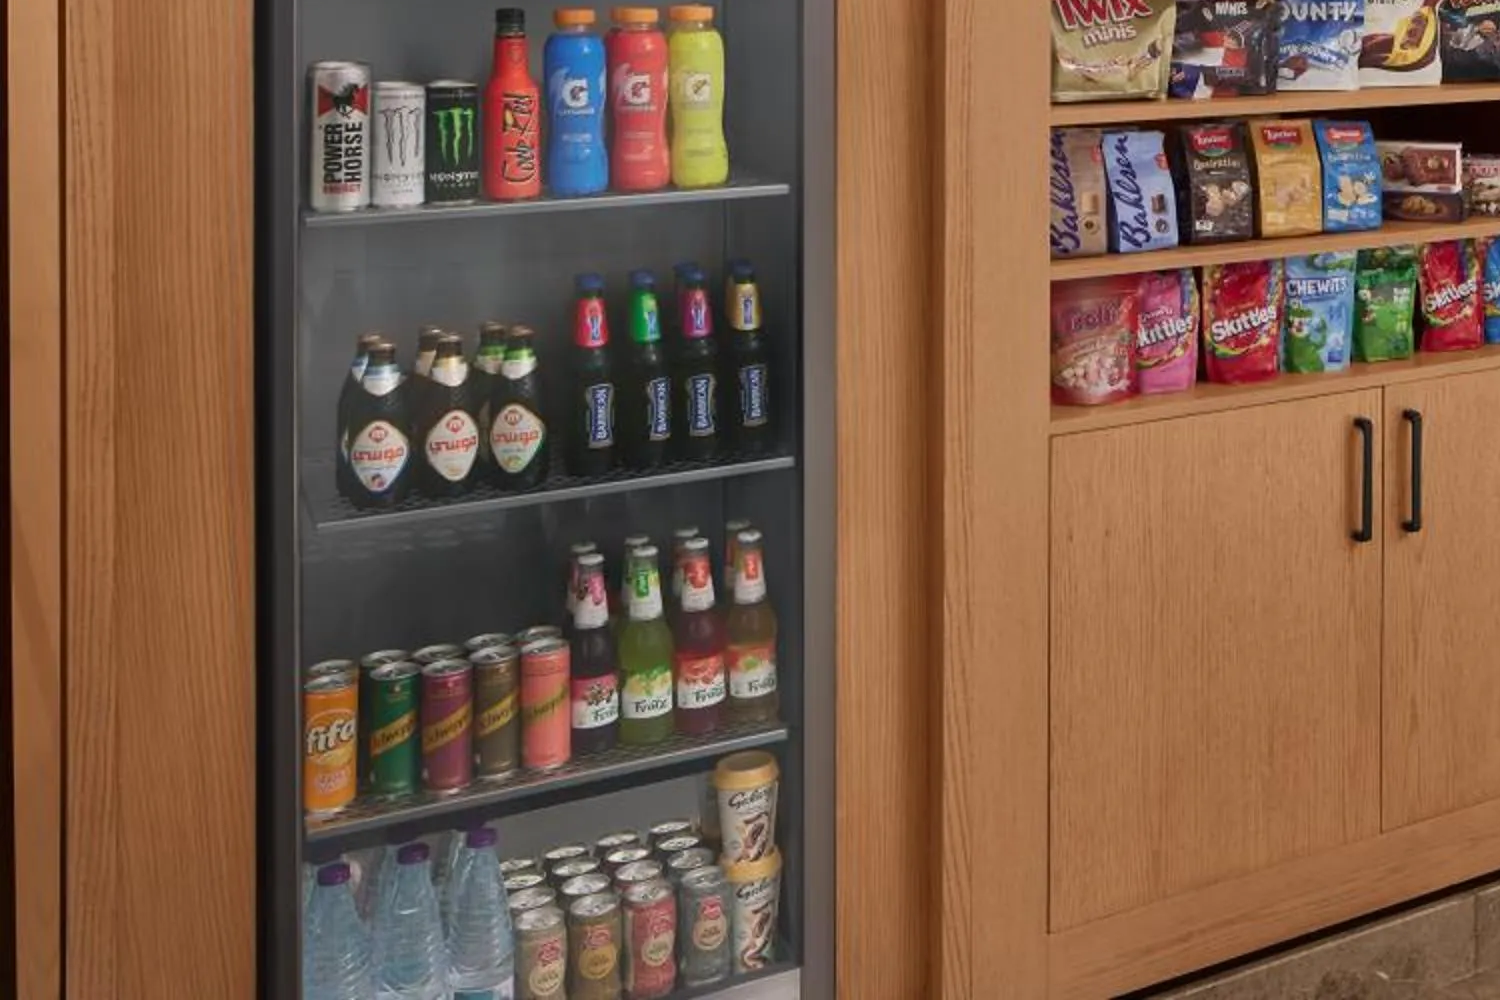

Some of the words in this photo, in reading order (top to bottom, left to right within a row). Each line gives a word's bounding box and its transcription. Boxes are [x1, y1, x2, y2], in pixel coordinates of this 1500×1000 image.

[1215, 1, 1249, 16] MINIS
[1083, 22, 1138, 49] minis
[323, 122, 343, 184] POWER
[343, 121, 363, 184] HORSE
[1112, 135, 1151, 248] Bahlsen
[1285, 276, 1348, 297] CHEWITS
[1137, 315, 1194, 348] kittles
[1211, 303, 1277, 343] Skittles
